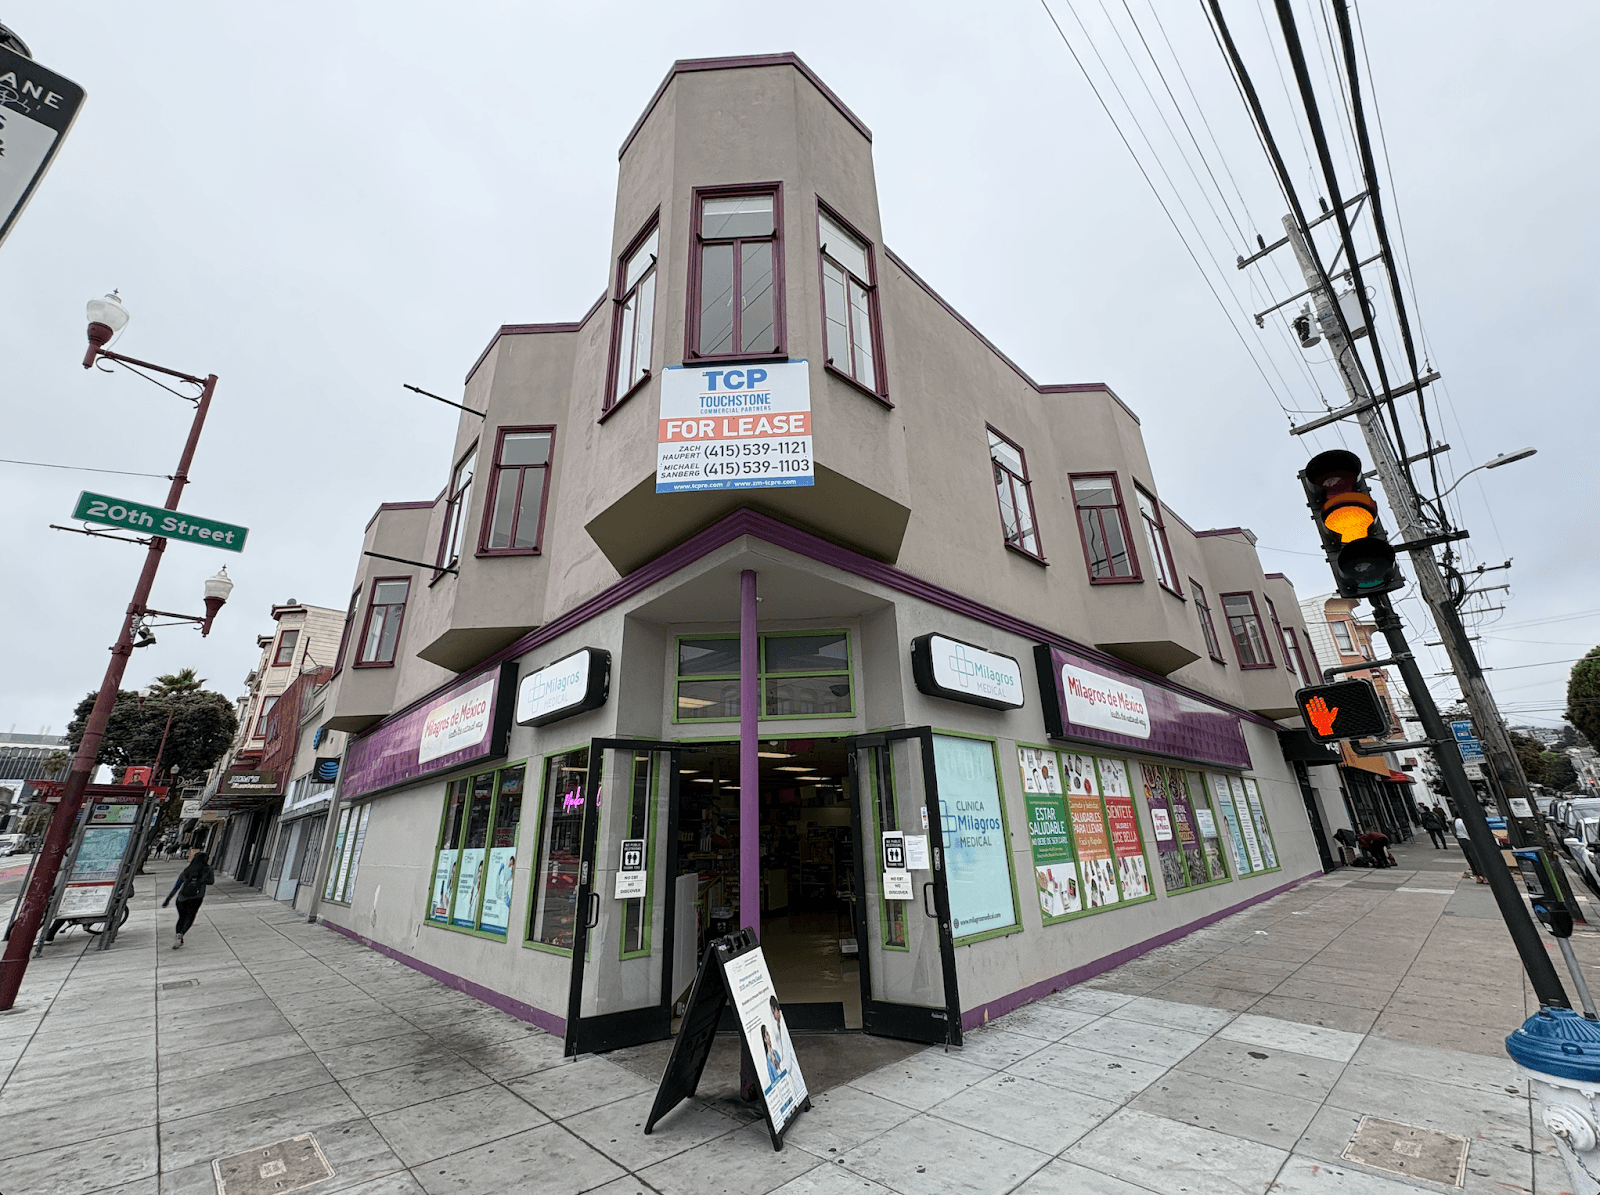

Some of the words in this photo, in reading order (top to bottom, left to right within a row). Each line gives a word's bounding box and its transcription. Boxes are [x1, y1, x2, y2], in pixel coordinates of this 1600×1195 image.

[704, 368, 768, 392] TCP
[699, 392, 771, 408] TOUCHSTONE
[666, 420, 715, 440] FOR
[722, 414, 805, 437] LEASE
[662, 452, 701, 461] HAUPERT
[678, 445, 701, 453] ZACH
[704, 444, 740, 460] (415)
[743, 441, 806, 457] 539-1121
[660, 470, 700, 479] SANBERG
[663, 463, 700, 471] MICHAEL
[704, 462, 740, 478] (415)
[743, 459, 810, 475] 539-1103
[674, 481, 724, 490] www.tcpre.com
[86, 500, 154, 528] 20th
[160, 516, 235, 545] Street
[974, 662, 1014, 686] Milagros
[544, 670, 580, 695] Milagros
[976, 682, 1006, 698] MEDICAL
[1068, 676, 1106, 706] Milagros
[1107, 688, 1118, 707] de
[544, 695, 568, 710] MEDICAL
[424, 716, 450, 738] Milagros
[450, 708, 460, 726] de
[956, 800, 984, 811] CLINICA
[1035, 807, 1056, 821] ESTAR
[958, 815, 1000, 834] Milagros
[1029, 821, 1066, 835] SALUDABLE
[960, 836, 992, 848] MEDICAL
